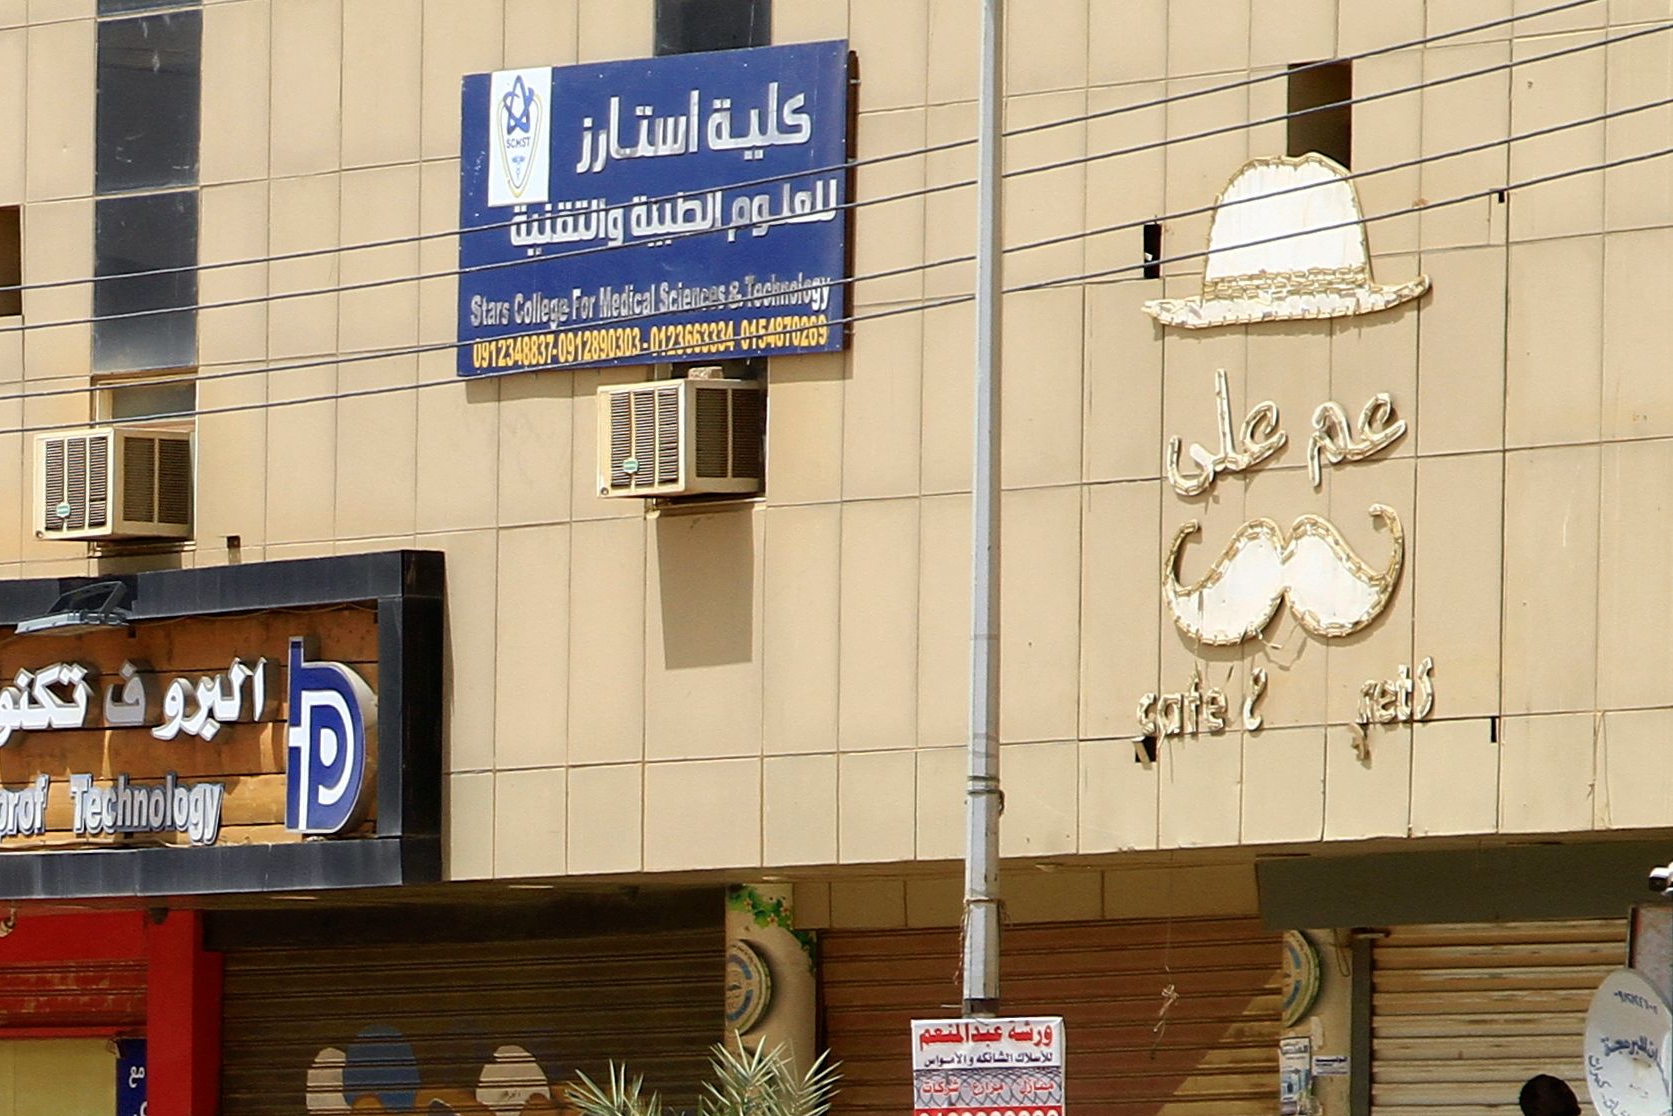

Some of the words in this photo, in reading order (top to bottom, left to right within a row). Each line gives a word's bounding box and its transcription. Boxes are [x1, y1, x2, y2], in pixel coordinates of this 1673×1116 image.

[707, 82, 812, 161] كلية
[509, 197, 625, 256] والتقنية
[630, 190, 723, 247] الطبية
[727, 179, 838, 243] للعلوم
[470, 294, 510, 326] Stars
[514, 292, 570, 330] College
[572, 288, 597, 320] For
[599, 284, 656, 318] Medical
[659, 281, 726, 314] Sciences
[728, 280, 743, 309] &
[744, 271, 831, 312] Technology
[1307, 391, 1409, 490] عم
[71, 770, 225, 847] Technology
[1008, 1020, 1053, 1047] ورشة
